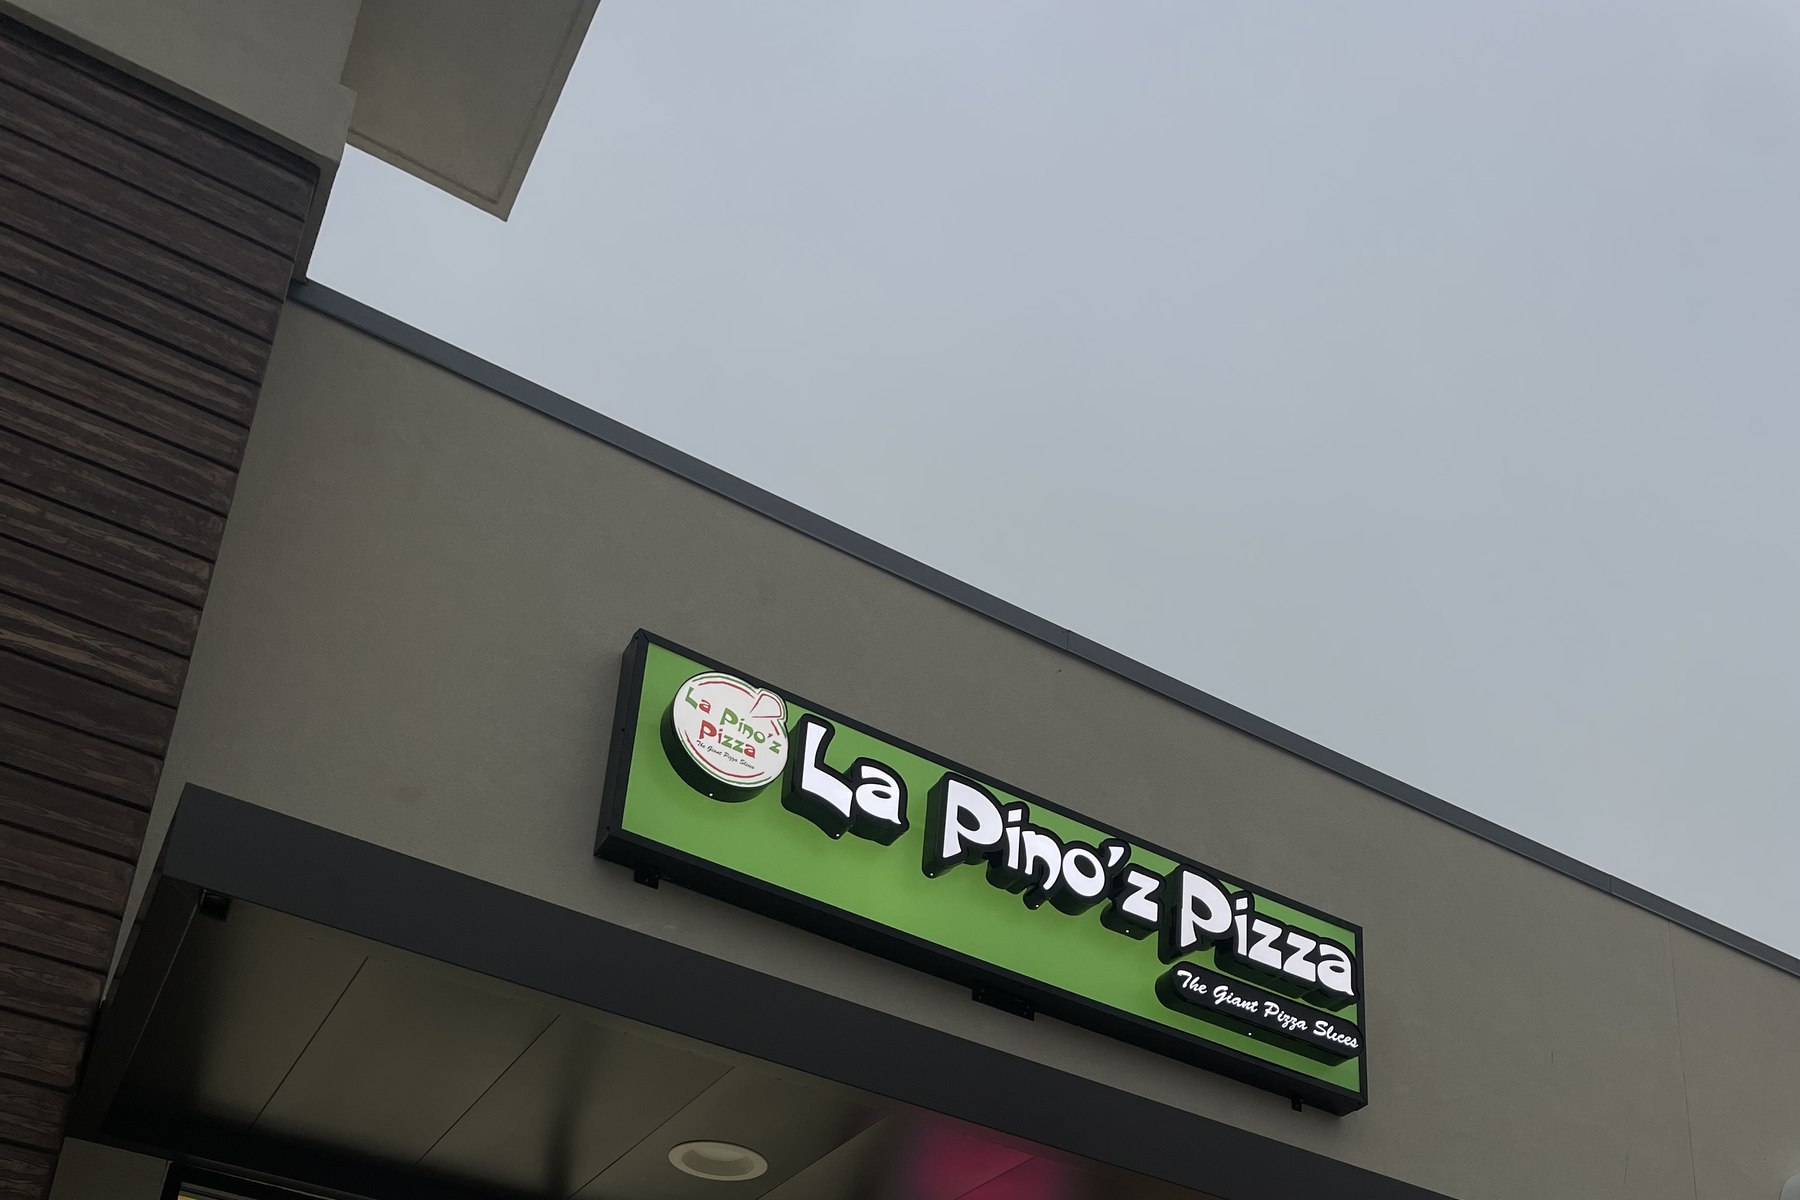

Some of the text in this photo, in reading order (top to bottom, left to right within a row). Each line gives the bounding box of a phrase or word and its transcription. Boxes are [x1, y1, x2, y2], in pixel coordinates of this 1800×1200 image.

[684, 686, 782, 755] La Pino'z
[696, 740, 706, 749] The
[698, 719, 756, 759] Pizza
[801, 721, 1354, 997] La Pino'z Pizza
[1177, 969, 1359, 1048] The Giant Pizza Slices
